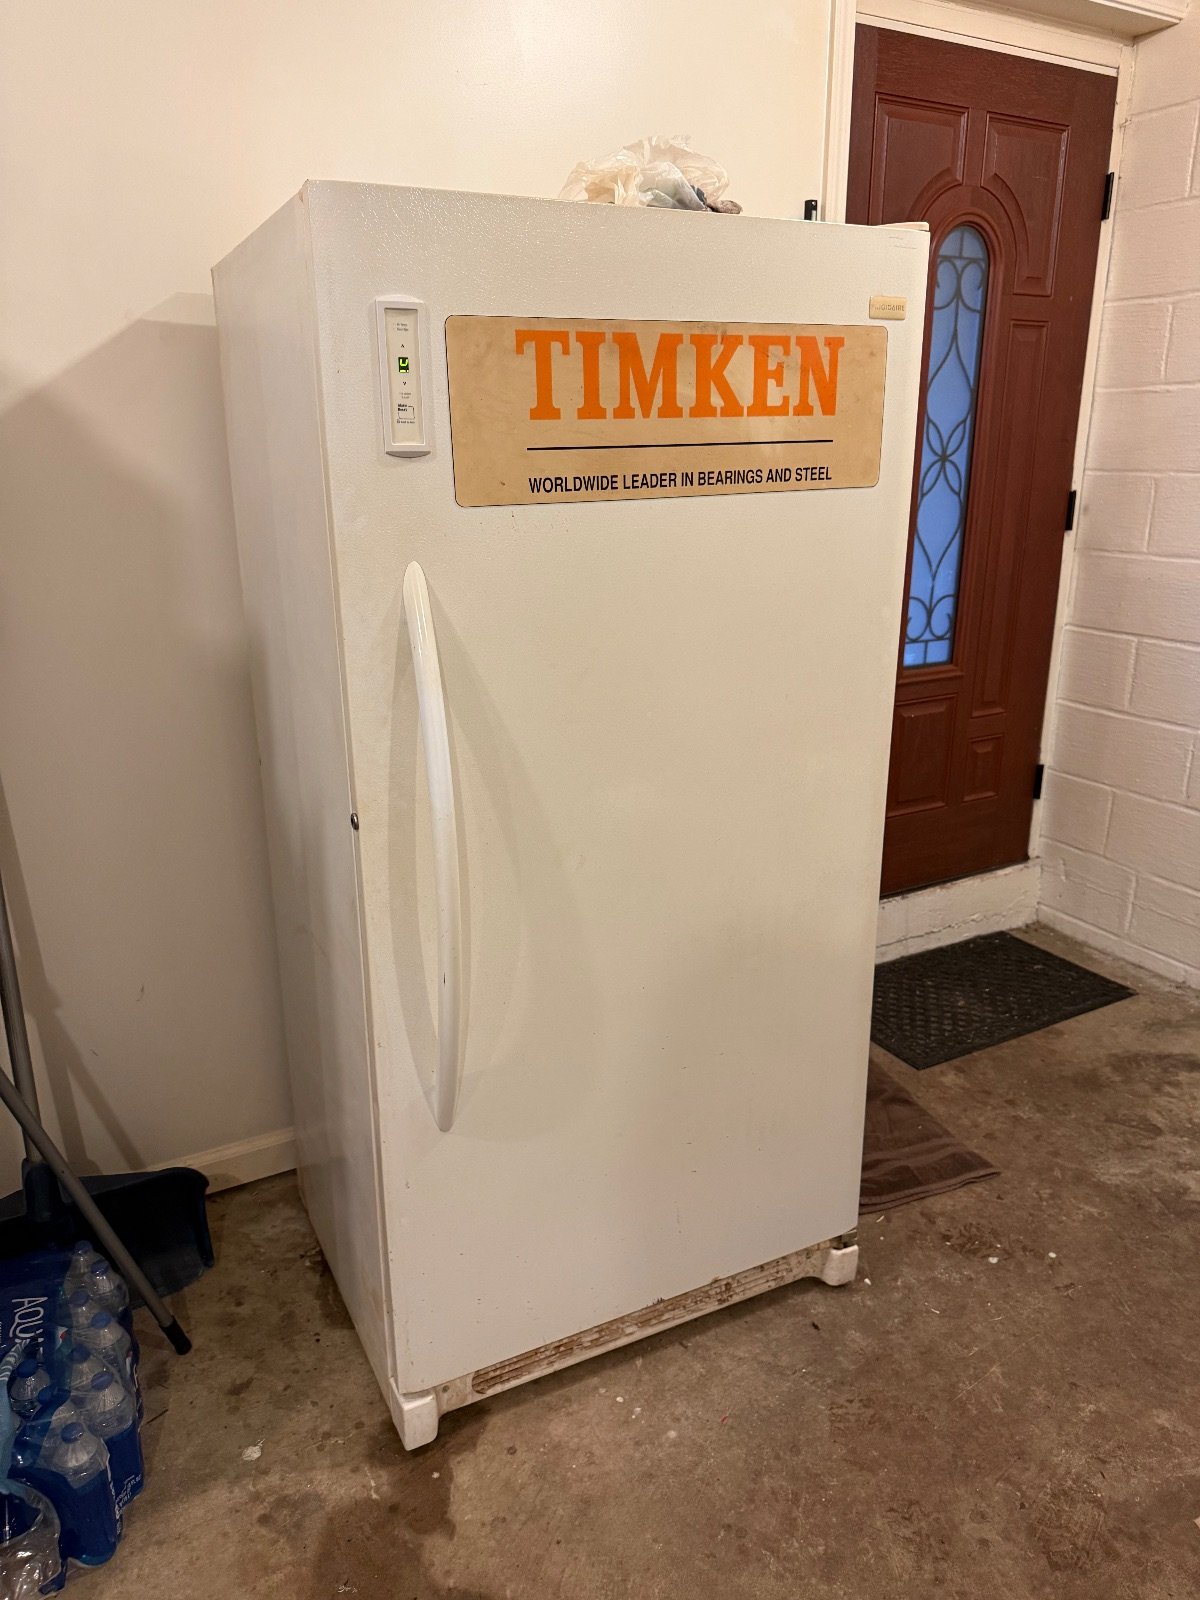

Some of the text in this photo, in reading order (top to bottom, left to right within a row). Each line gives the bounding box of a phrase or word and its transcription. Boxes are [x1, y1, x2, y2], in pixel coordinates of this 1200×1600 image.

[515, 329, 846, 421] TIMKEN
[528, 466, 832, 493] WORLDWIDE LEADER IN BEARINGS AND STEEL
